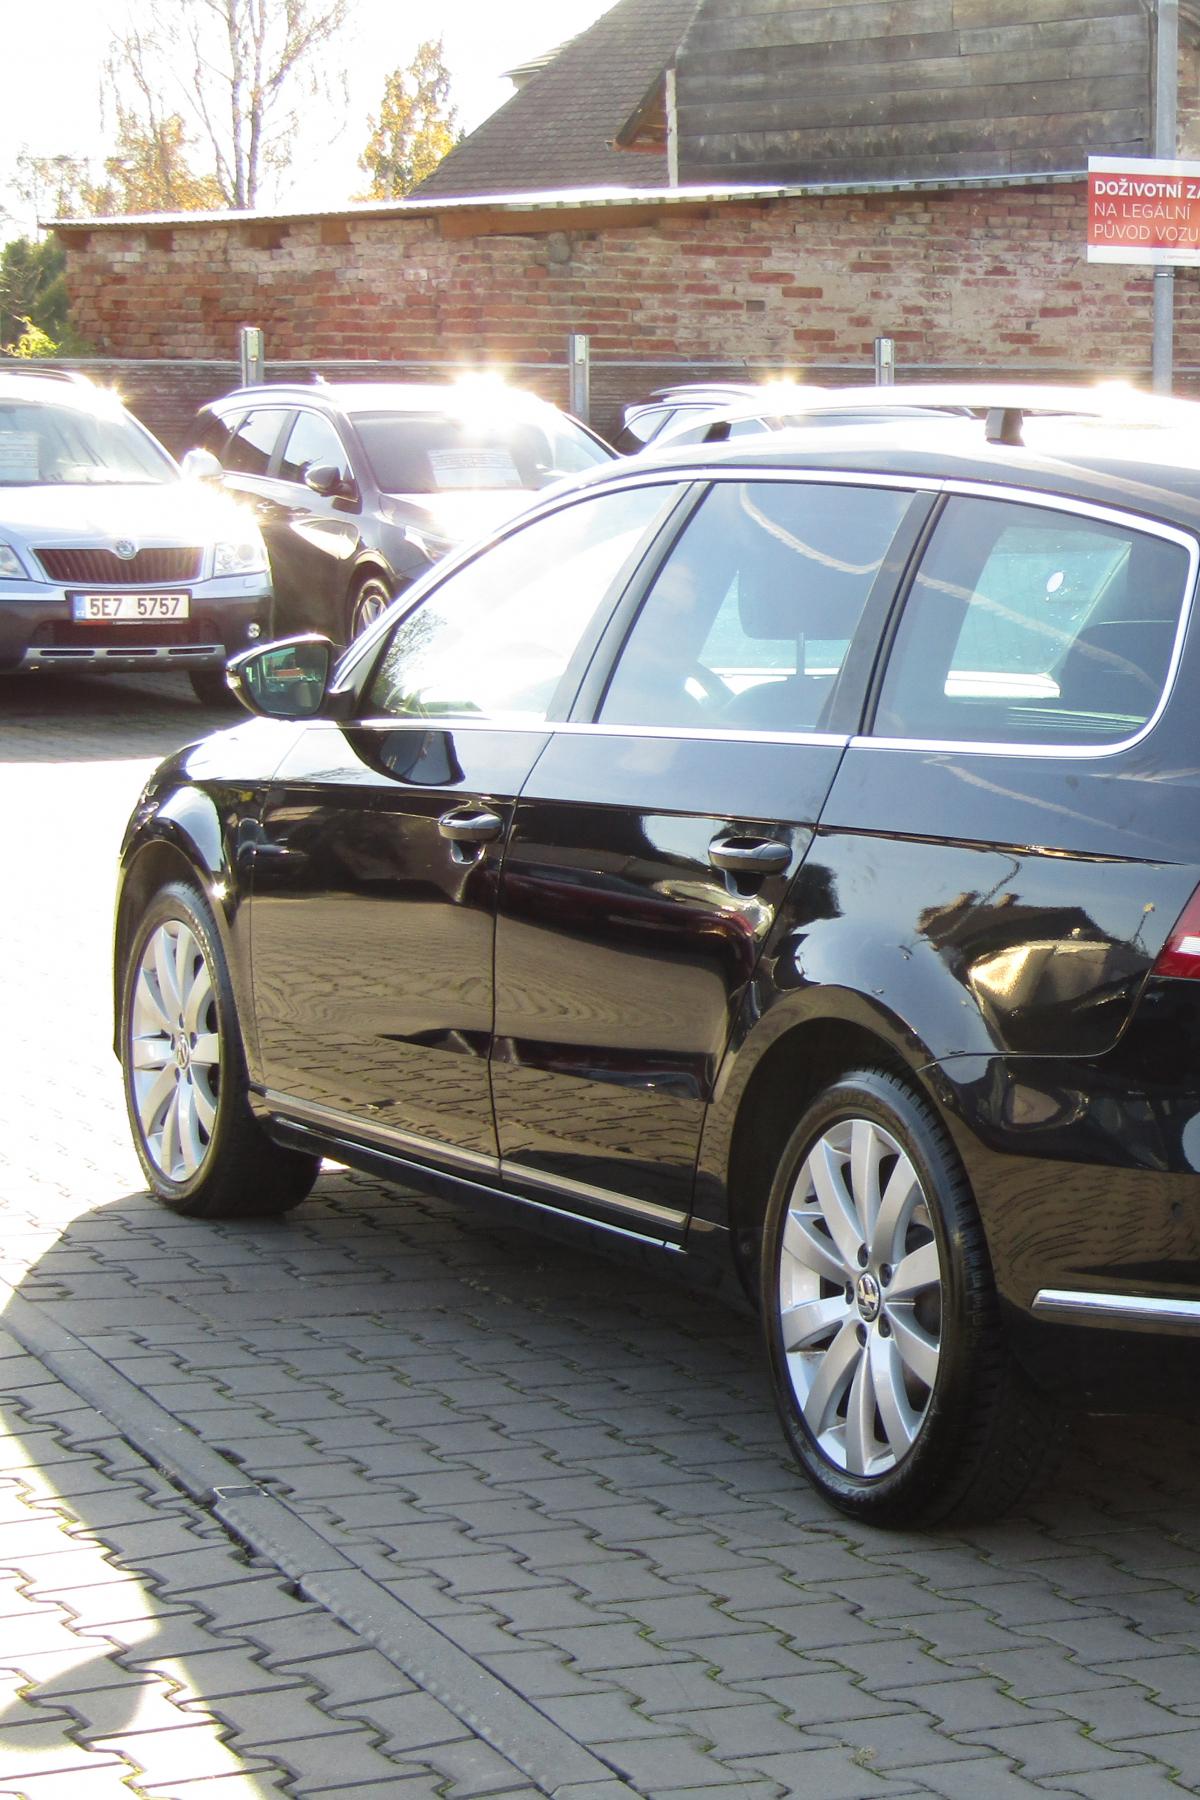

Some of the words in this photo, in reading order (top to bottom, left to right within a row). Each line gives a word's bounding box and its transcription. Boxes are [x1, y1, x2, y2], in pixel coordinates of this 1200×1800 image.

[1094, 178, 1182, 199] DOŽIVOTNÍ
[1094, 203, 1117, 217] NA
[1122, 202, 1191, 220] LEGÁLNÍ
[1094, 220, 1150, 240] PŮVOD
[1155, 226, 1200, 242] VOZU
[90, 598, 123, 616] 5E7
[137, 597, 180, 616] 5757
